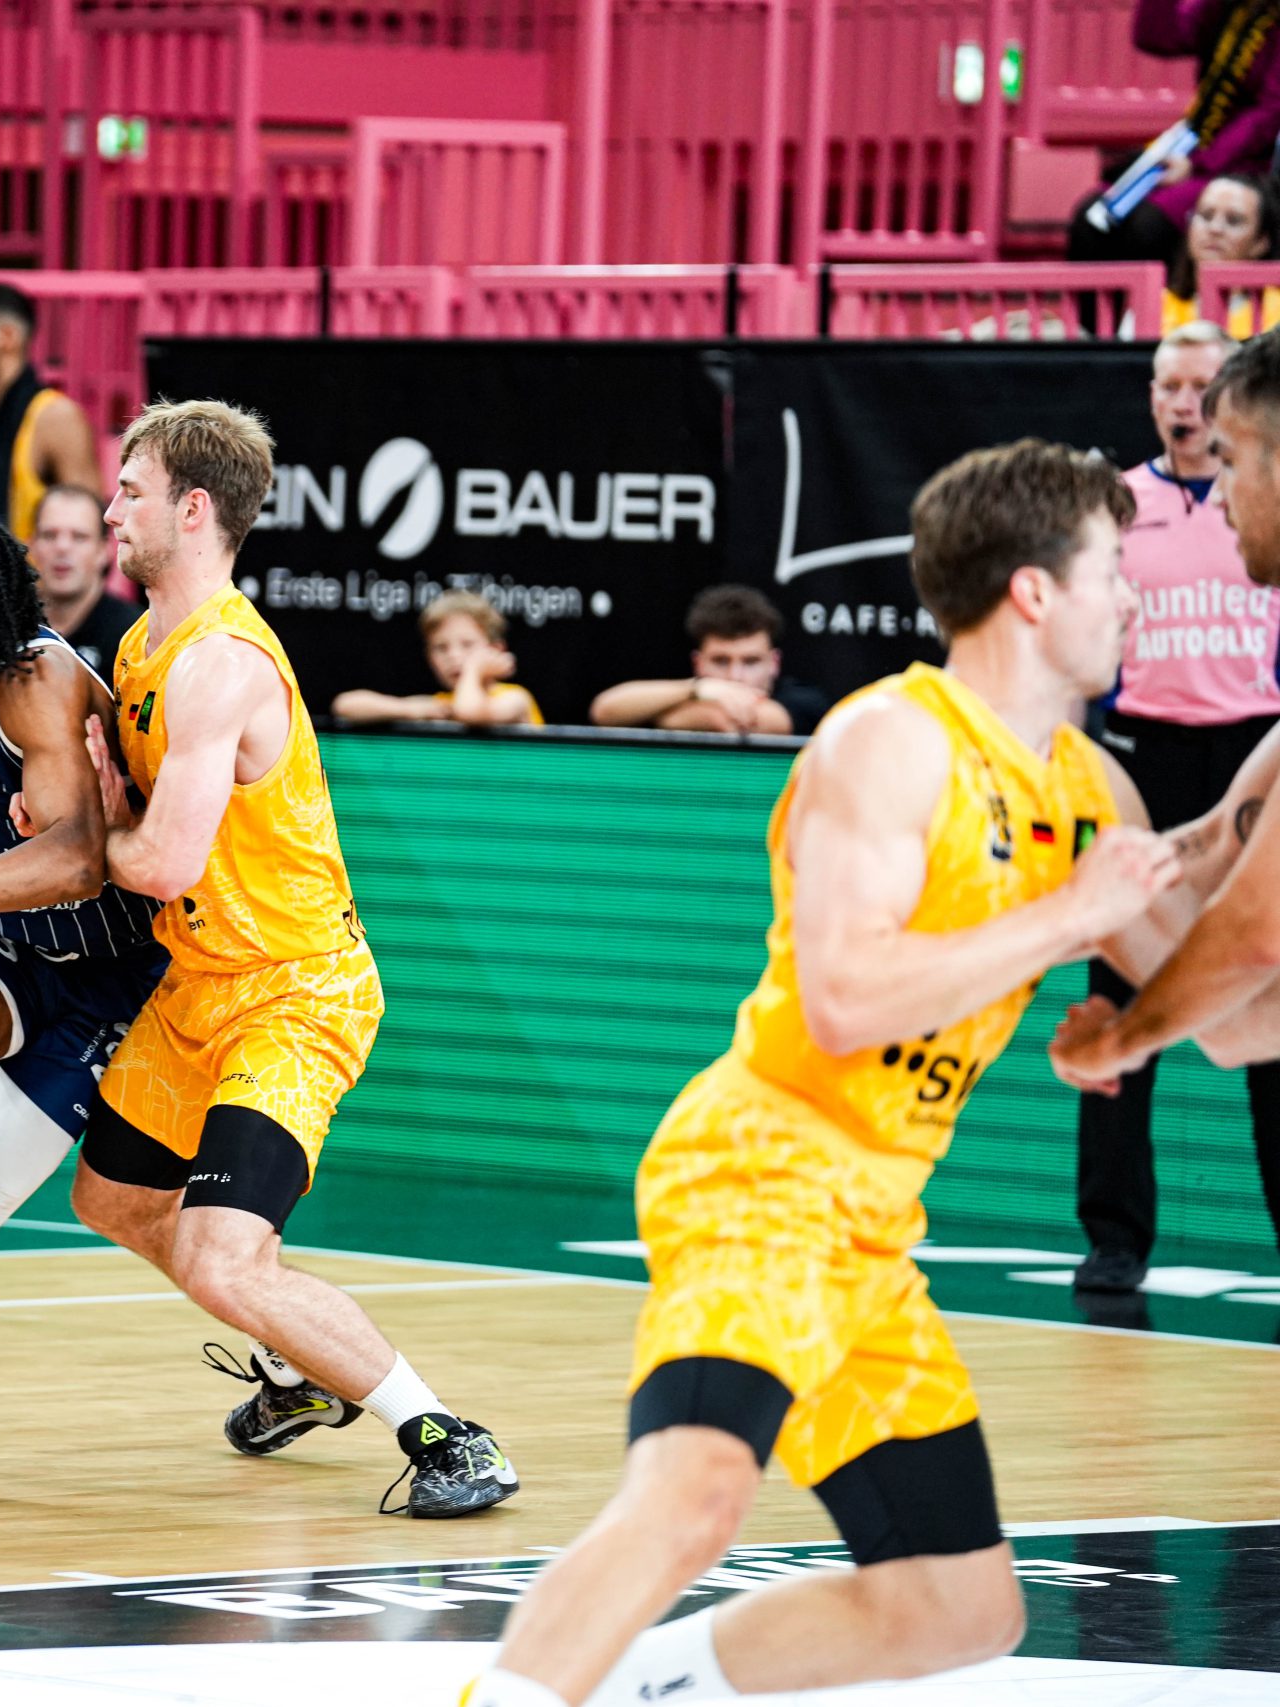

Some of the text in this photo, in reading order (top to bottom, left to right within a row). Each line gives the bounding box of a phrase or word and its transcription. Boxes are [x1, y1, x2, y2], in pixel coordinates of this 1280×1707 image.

[455, 468, 716, 543] BAUER
[265, 567, 343, 609] Erste
[345, 569, 411, 621] Liga
[446, 573, 583, 627] Tbingen
